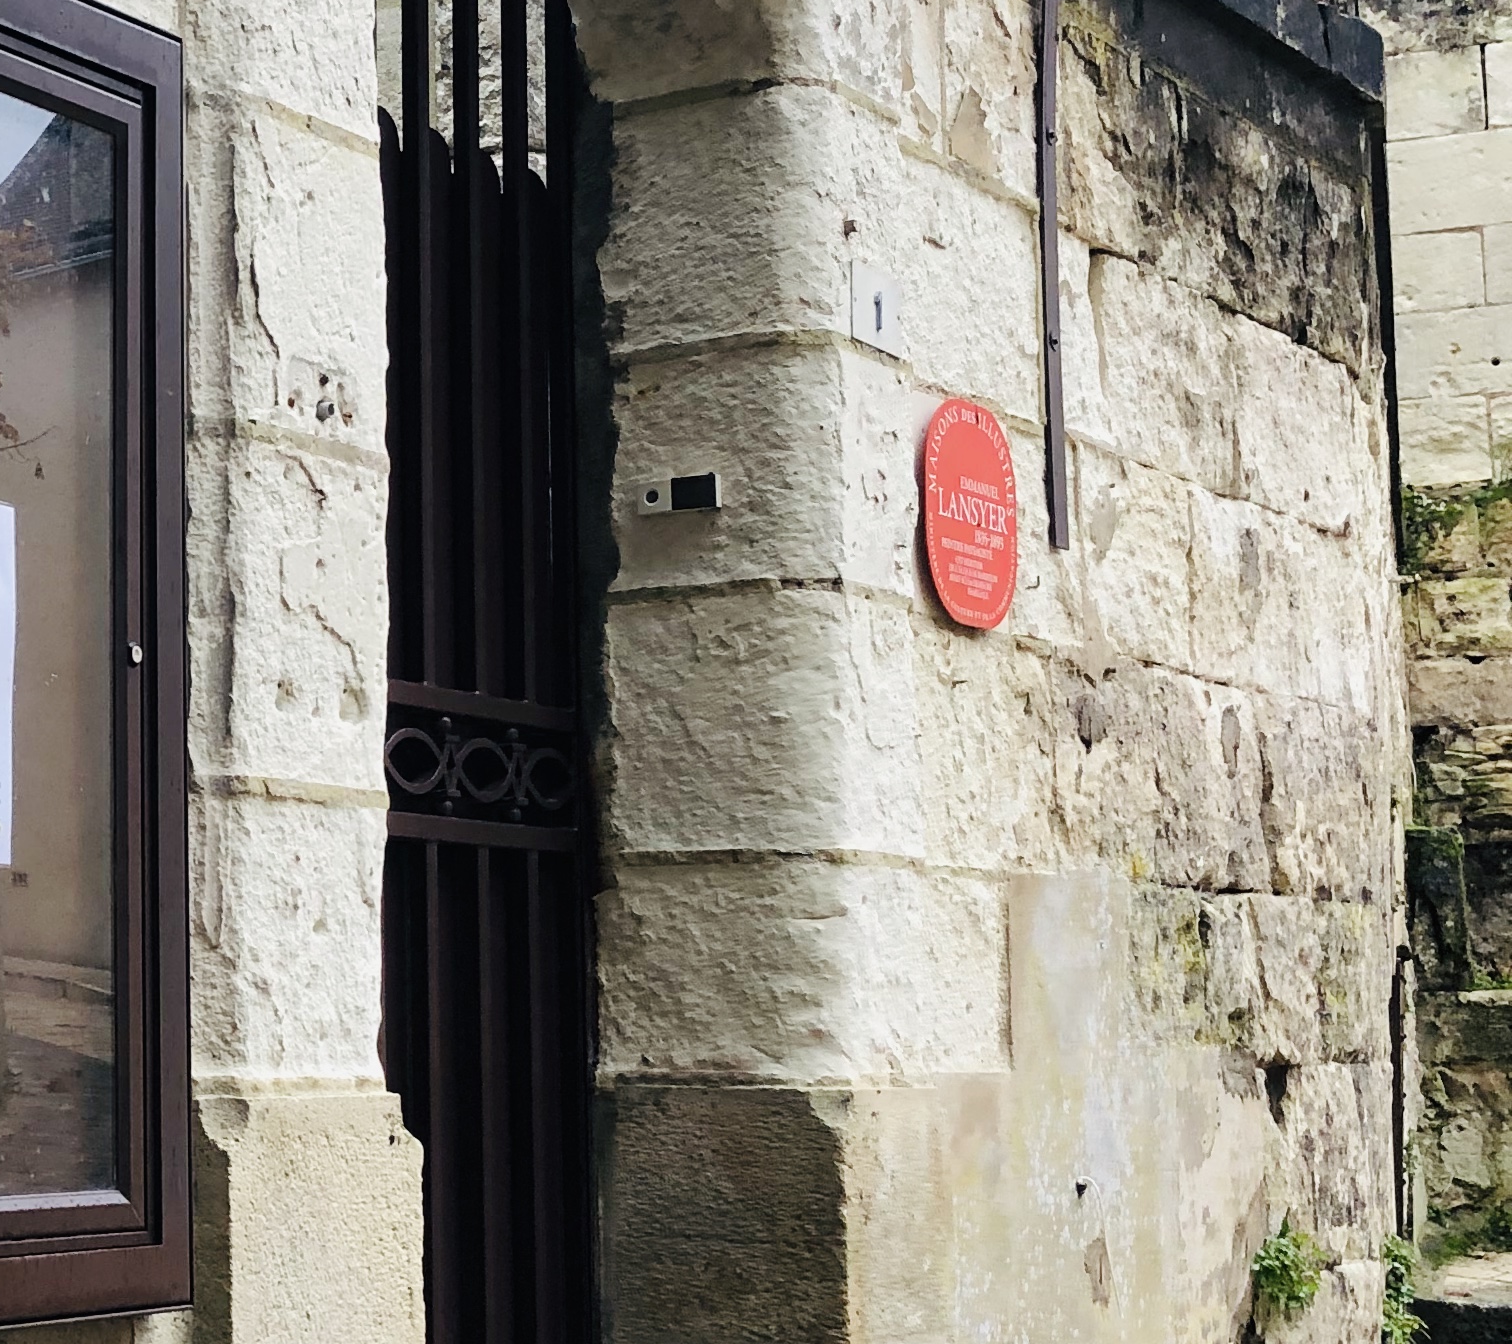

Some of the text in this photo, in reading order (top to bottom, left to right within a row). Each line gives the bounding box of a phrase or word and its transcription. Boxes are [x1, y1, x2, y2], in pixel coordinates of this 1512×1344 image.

[929, 406, 959, 494] MAISONS
[978, 413, 1014, 517] ILLUSTRES
[938, 487, 1008, 534] LANSYER
